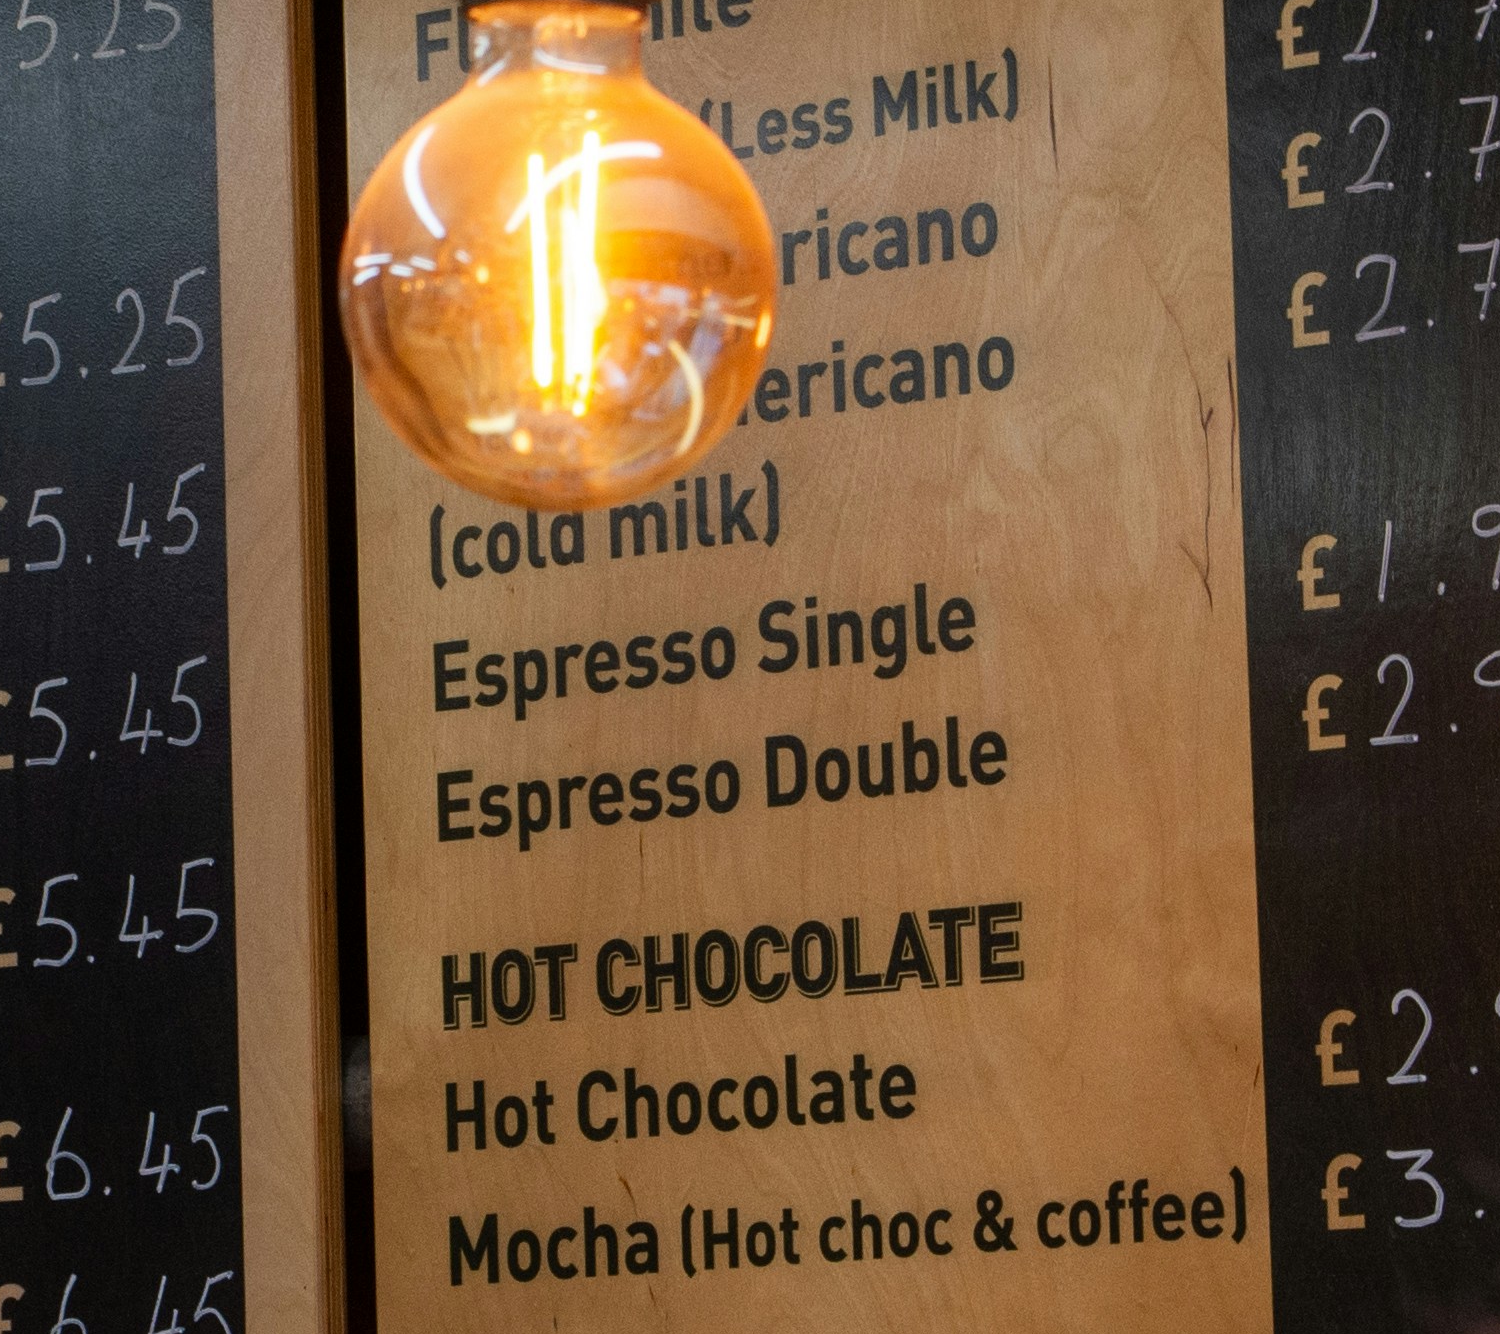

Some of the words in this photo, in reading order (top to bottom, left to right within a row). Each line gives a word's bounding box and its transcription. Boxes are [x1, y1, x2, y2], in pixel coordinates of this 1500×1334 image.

[872, 46, 1019, 136] Milk)
[609, 460, 781, 560] milk)
[433, 626, 736, 722] Espresso
[758, 583, 976, 680] Single
[437, 759, 741, 852] Espresso
[765, 716, 1008, 808] Double
[441, 943, 578, 1030] HOT
[595, 901, 1025, 1017] CHOCOLATE
[445, 1079, 556, 1153] Hot
[577, 1053, 917, 1143] Chocolate
[449, 1206, 659, 1287] Mocha
[680, 1204, 801, 1278] (Hot
[819, 1199, 953, 1263] choc
[973, 1189, 1017, 1253] &
[1036, 1166, 1248, 1249] coffee)
